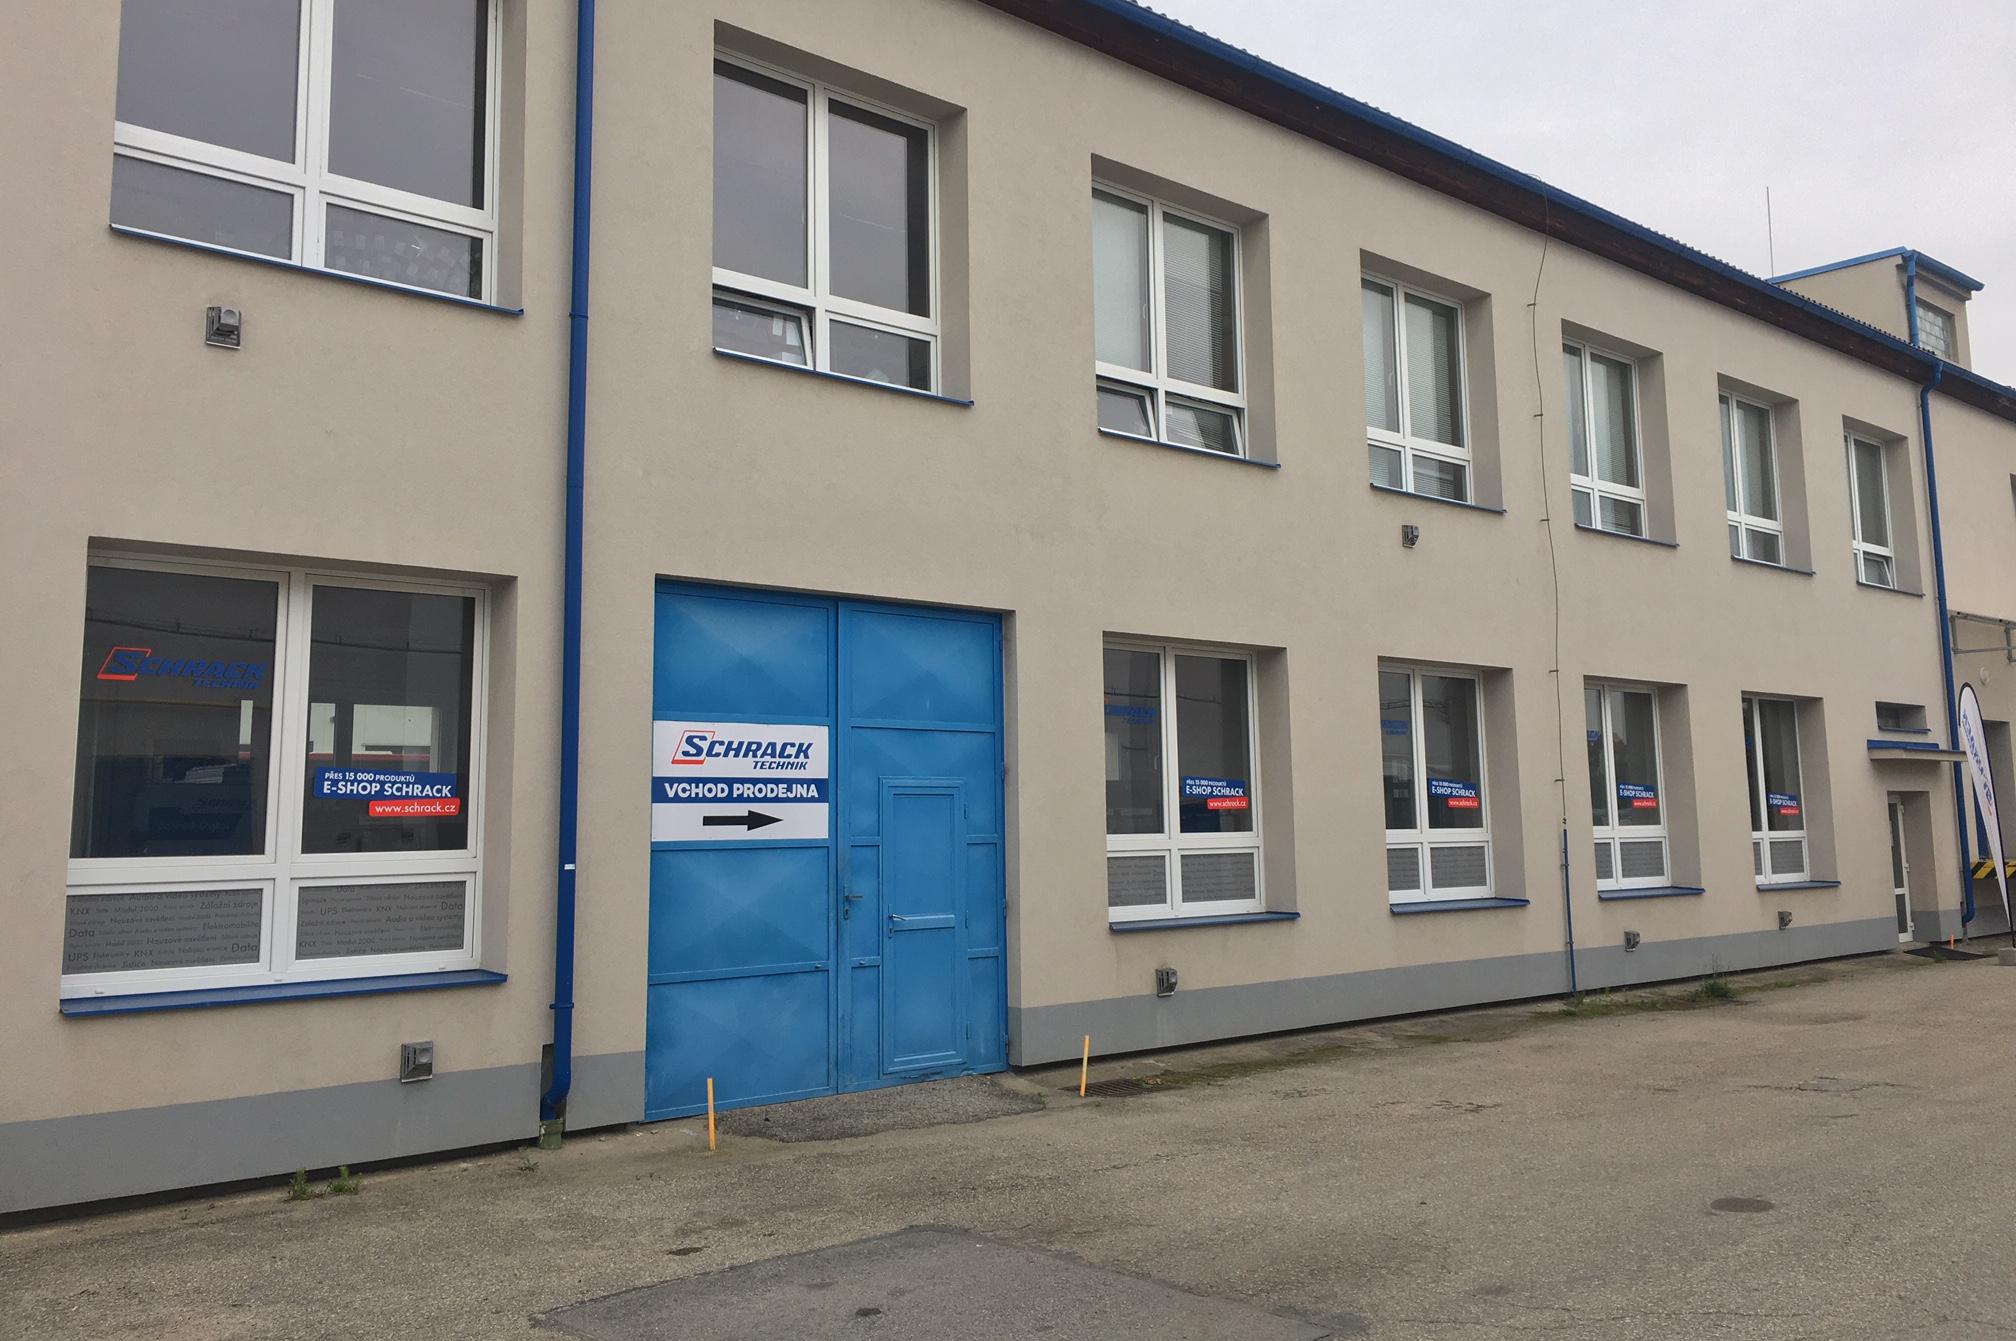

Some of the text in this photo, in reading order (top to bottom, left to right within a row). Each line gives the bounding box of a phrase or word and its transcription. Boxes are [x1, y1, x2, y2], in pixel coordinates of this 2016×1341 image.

[110, 651, 268, 680] SCHRACK
[681, 735, 813, 760] SCHRACK
[753, 760, 808, 770] TECHNIK
[325, 770, 415, 783] PŘES 15 000 PRODUKTŮ
[323, 781, 452, 798] E-SHOP SCHRACK
[664, 782, 819, 799] VCHOD PRODEJNA
[1186, 785, 1244, 797] E-SHOP SCHRACK
[1432, 786, 1476, 797] E-SHOP SCHRACK
[375, 801, 456, 813] www.schrack.cz
[70, 906, 89, 915] KNX
[441, 900, 463, 911] Data
[69, 928, 95, 938] Data
[231, 942, 258, 953] Data
[68, 951, 89, 962] UPS
